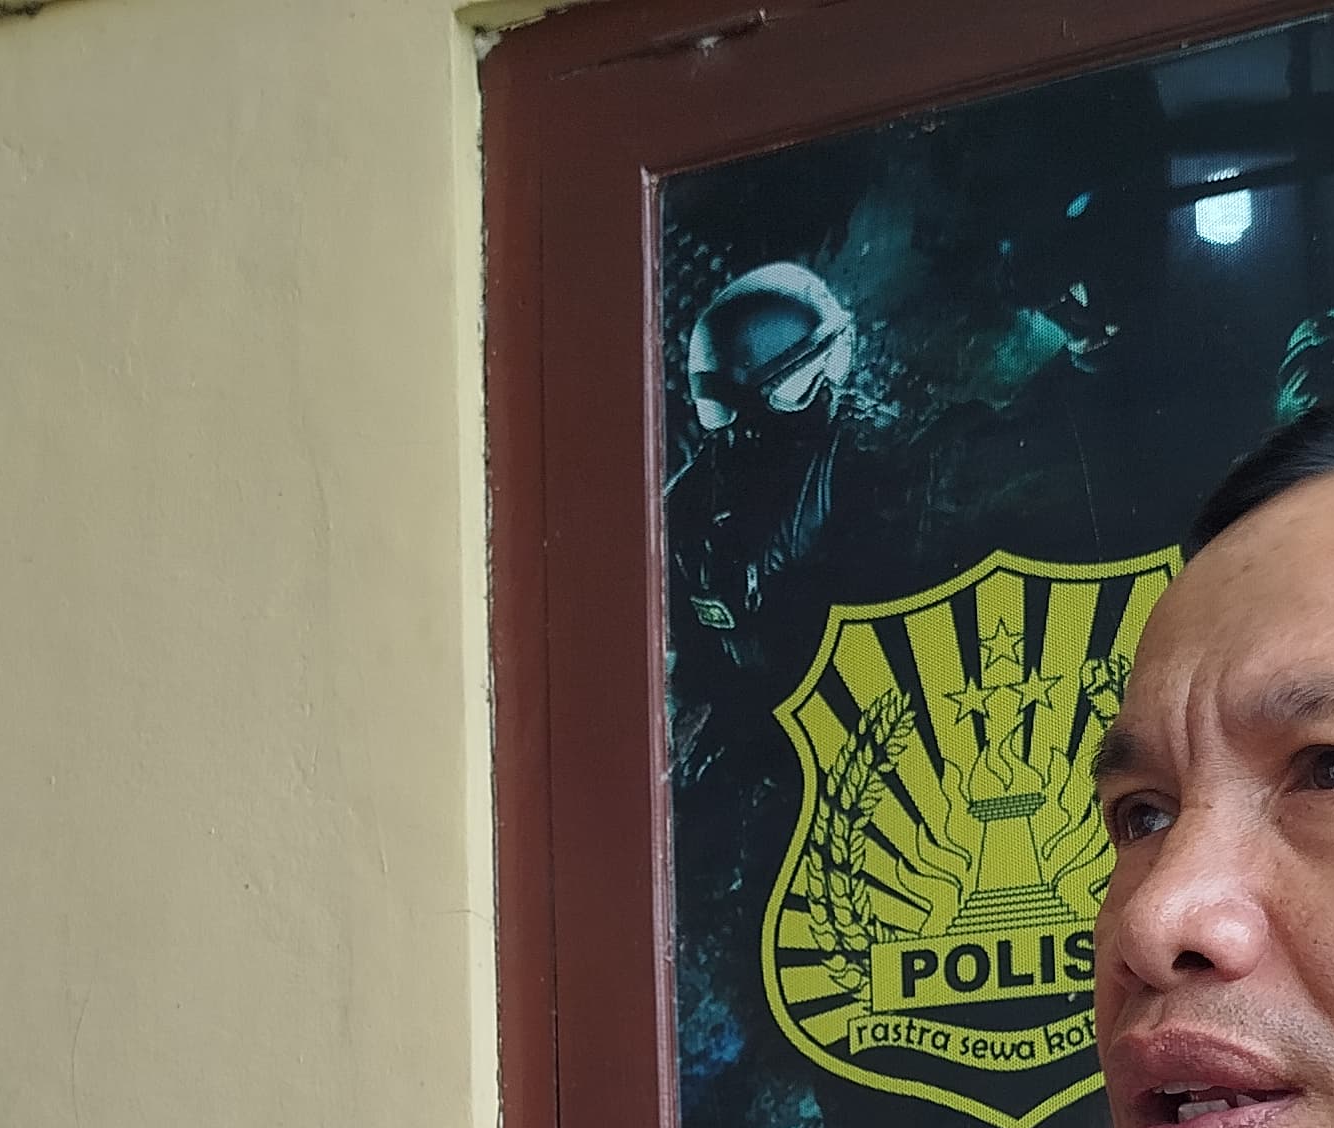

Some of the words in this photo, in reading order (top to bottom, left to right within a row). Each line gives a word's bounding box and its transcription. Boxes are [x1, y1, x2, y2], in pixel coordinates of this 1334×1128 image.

[901, 930, 1096, 998] POLIS
[856, 1018, 951, 1051] rastra
[960, 1034, 1036, 1061] sewa
